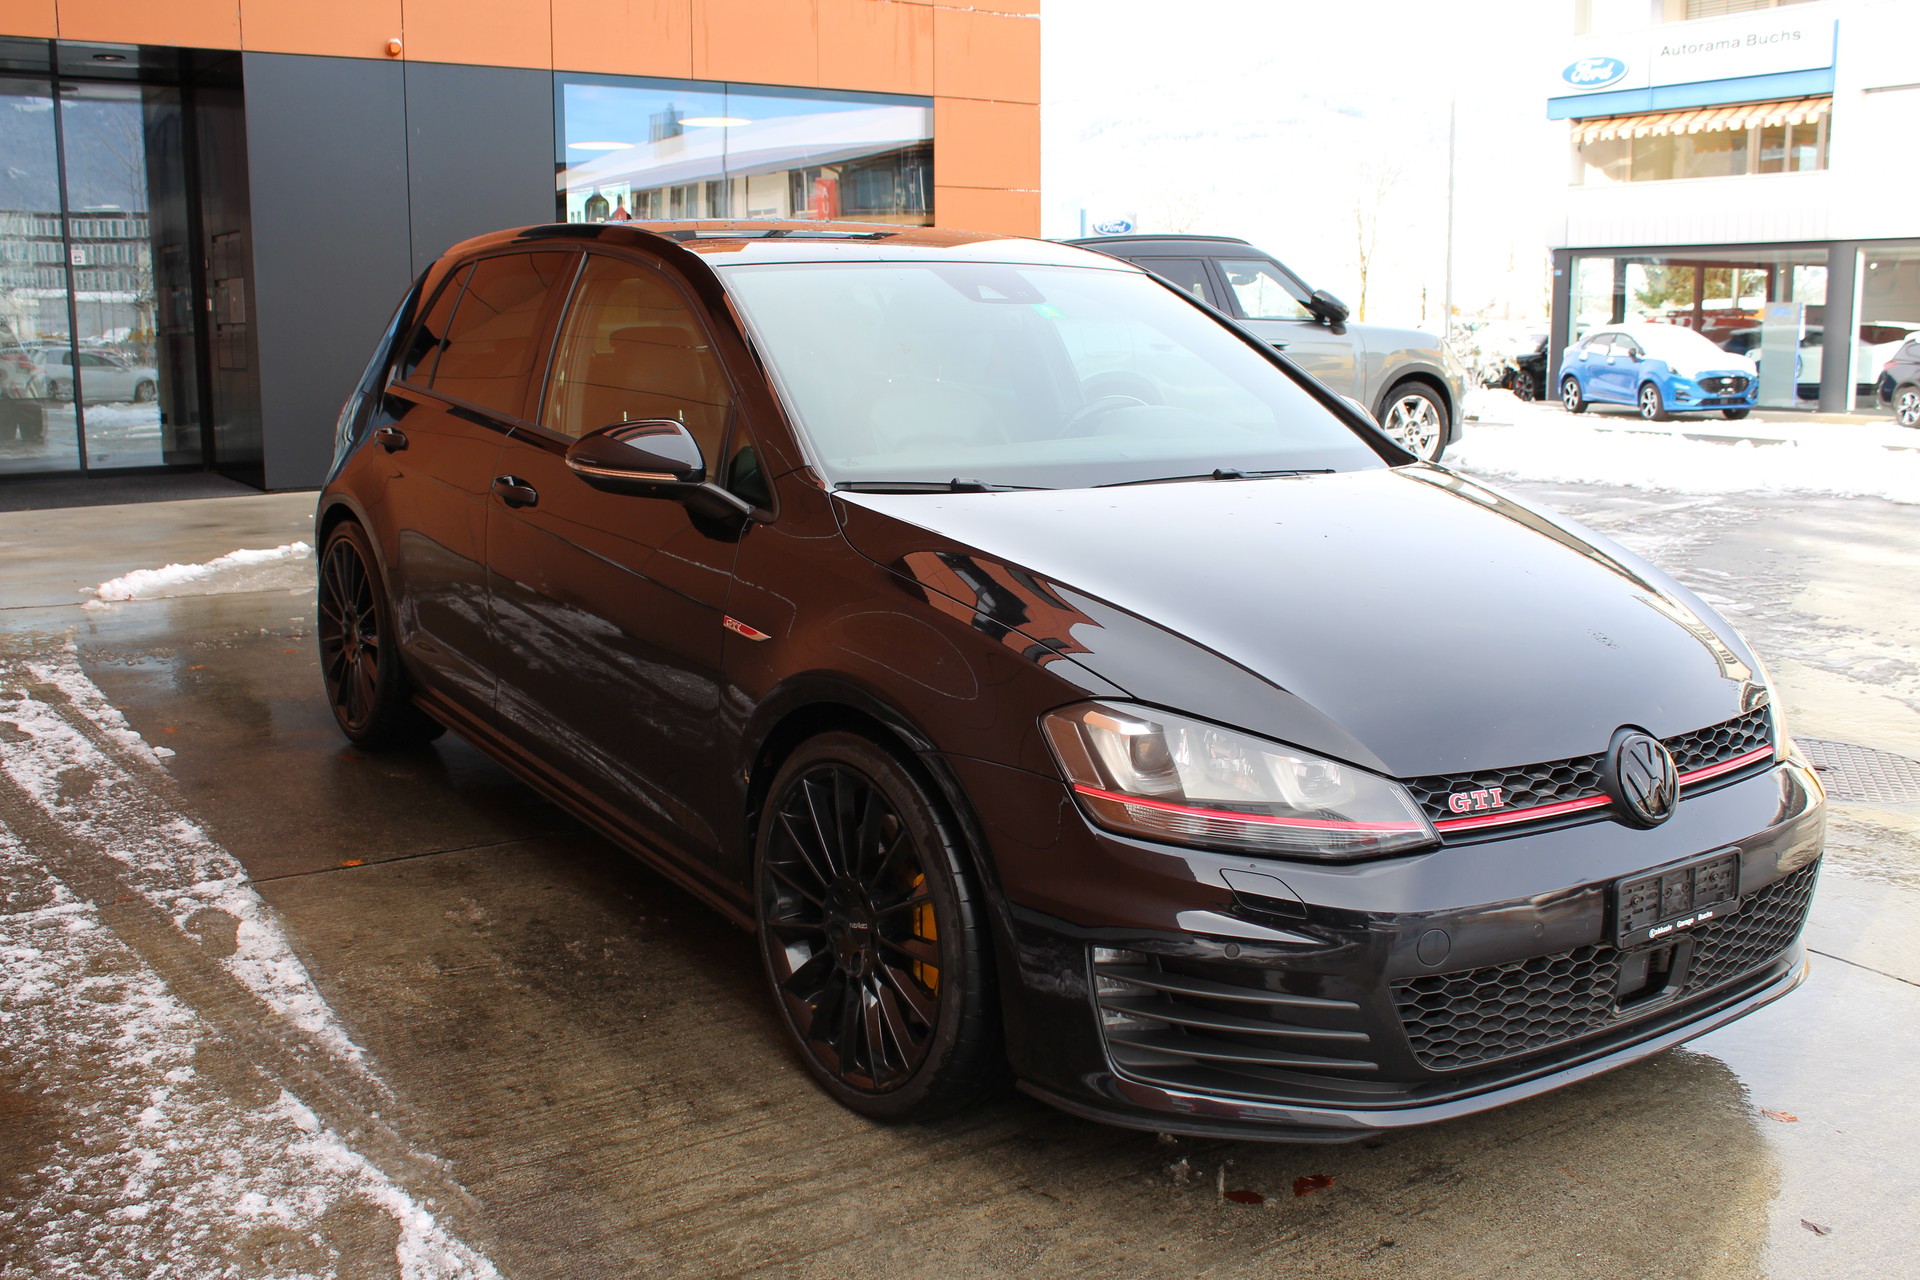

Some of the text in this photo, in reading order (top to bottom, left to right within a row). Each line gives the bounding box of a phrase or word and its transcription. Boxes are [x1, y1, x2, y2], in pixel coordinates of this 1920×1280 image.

[1660, 30, 1801, 57] Autorama Buchs
[1448, 787, 1505, 814] GTI
